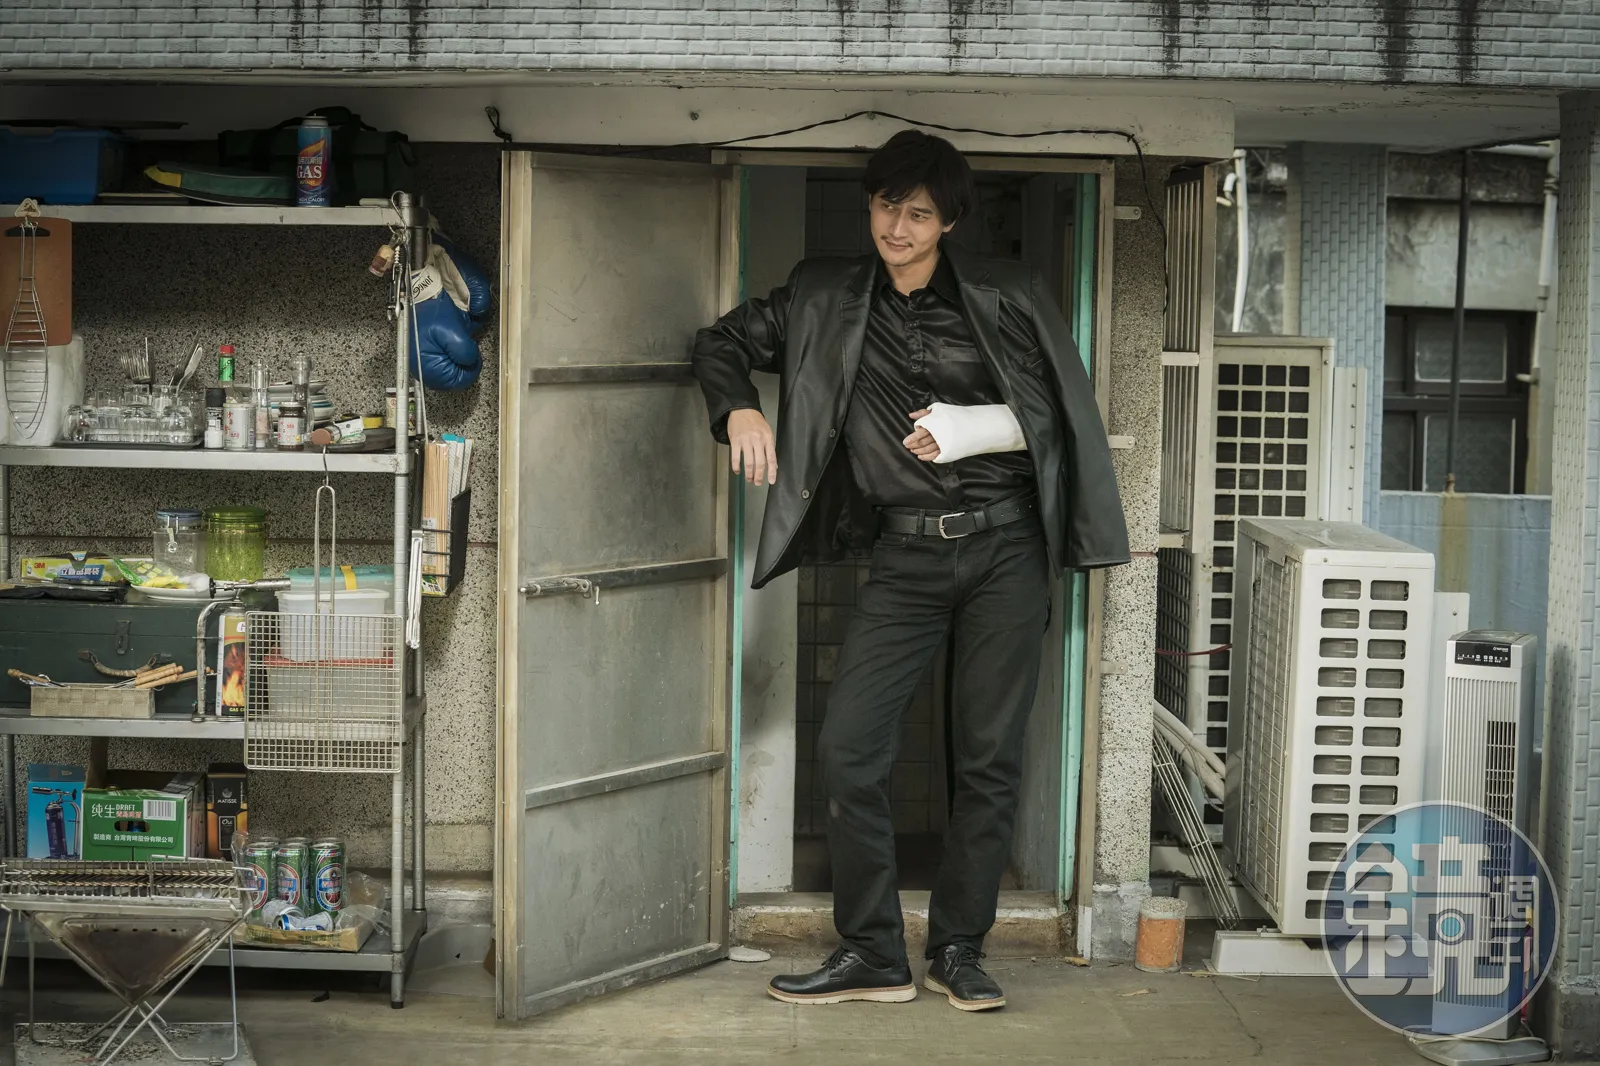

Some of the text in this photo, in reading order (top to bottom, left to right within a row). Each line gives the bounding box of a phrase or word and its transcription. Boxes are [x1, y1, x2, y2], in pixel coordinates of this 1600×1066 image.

[297, 165, 322, 179] GAS
[93, 833, 174, 844] 製造商 台灣青啤股份有限公司
